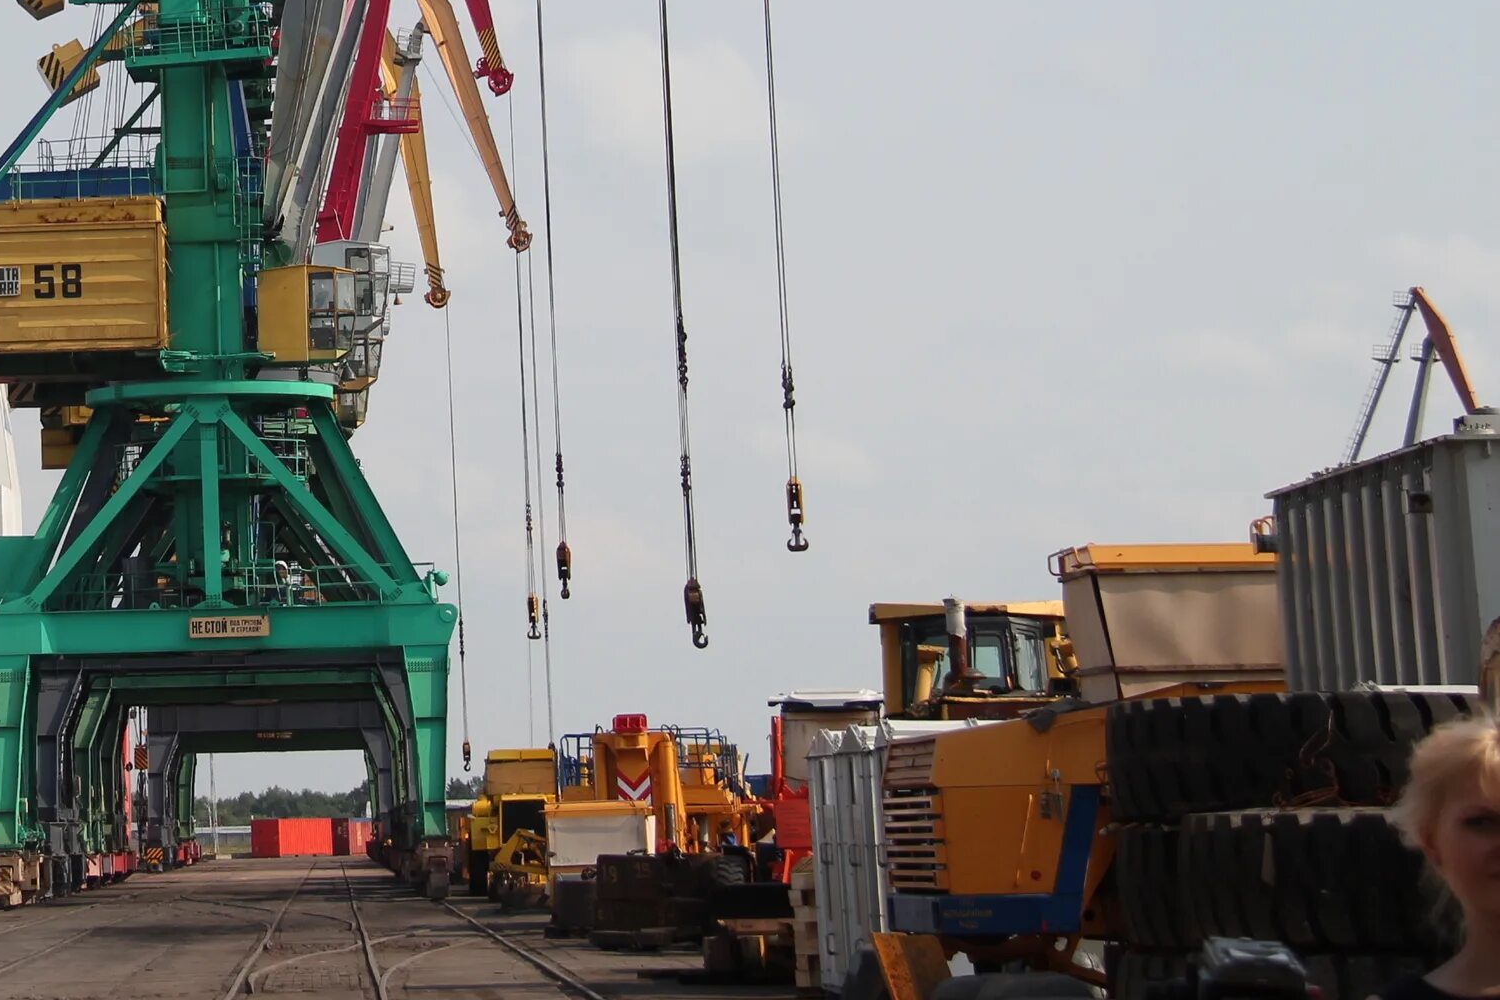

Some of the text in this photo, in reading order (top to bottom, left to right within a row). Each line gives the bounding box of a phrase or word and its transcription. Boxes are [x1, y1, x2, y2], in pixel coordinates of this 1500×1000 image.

[34, 264, 82, 299] 58
[192, 617, 228, 634] НЕ СТОЙ
